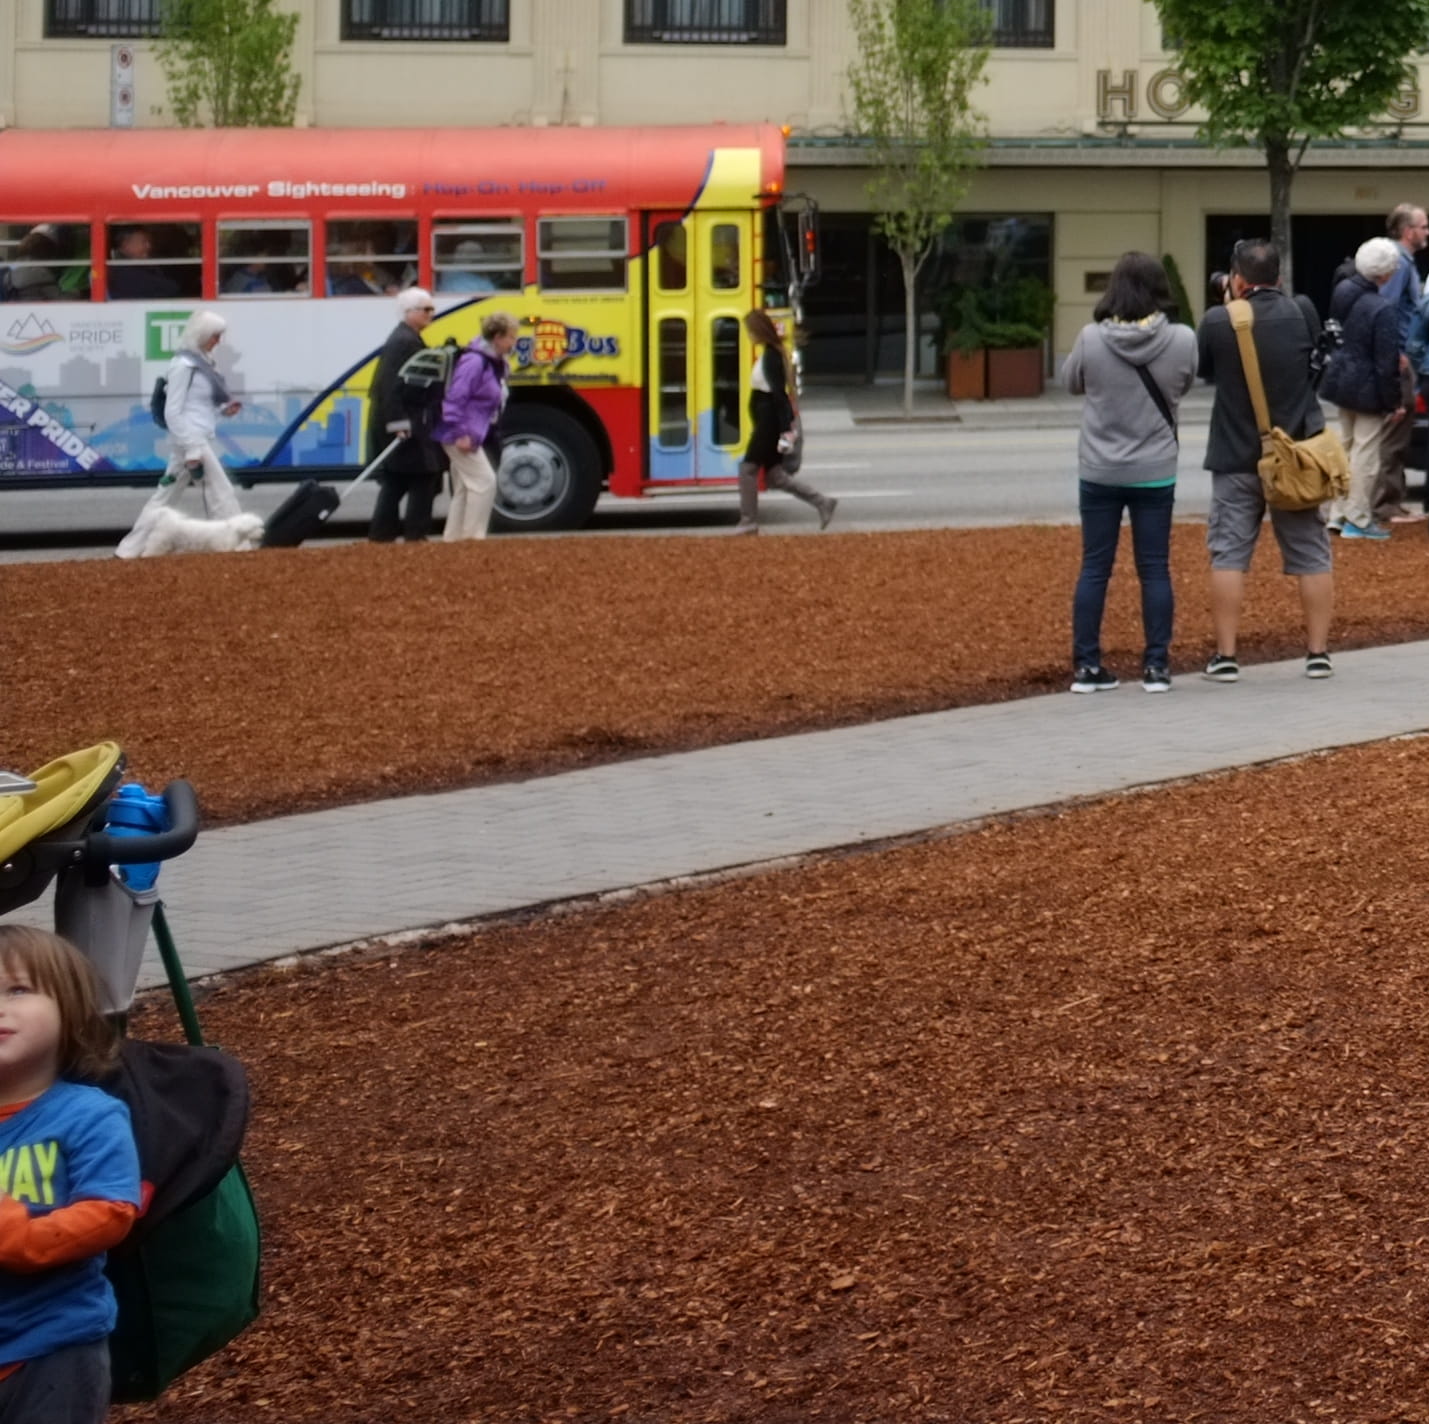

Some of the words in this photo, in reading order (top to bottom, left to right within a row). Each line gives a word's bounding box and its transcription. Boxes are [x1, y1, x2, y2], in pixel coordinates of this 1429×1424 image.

[132, 184, 260, 199] Vancouver
[267, 180, 406, 199] Sightseeing
[69, 329, 124, 344] PRIDE
[566, 327, 617, 355] Bus
[27, 407, 99, 471] PRIDE
